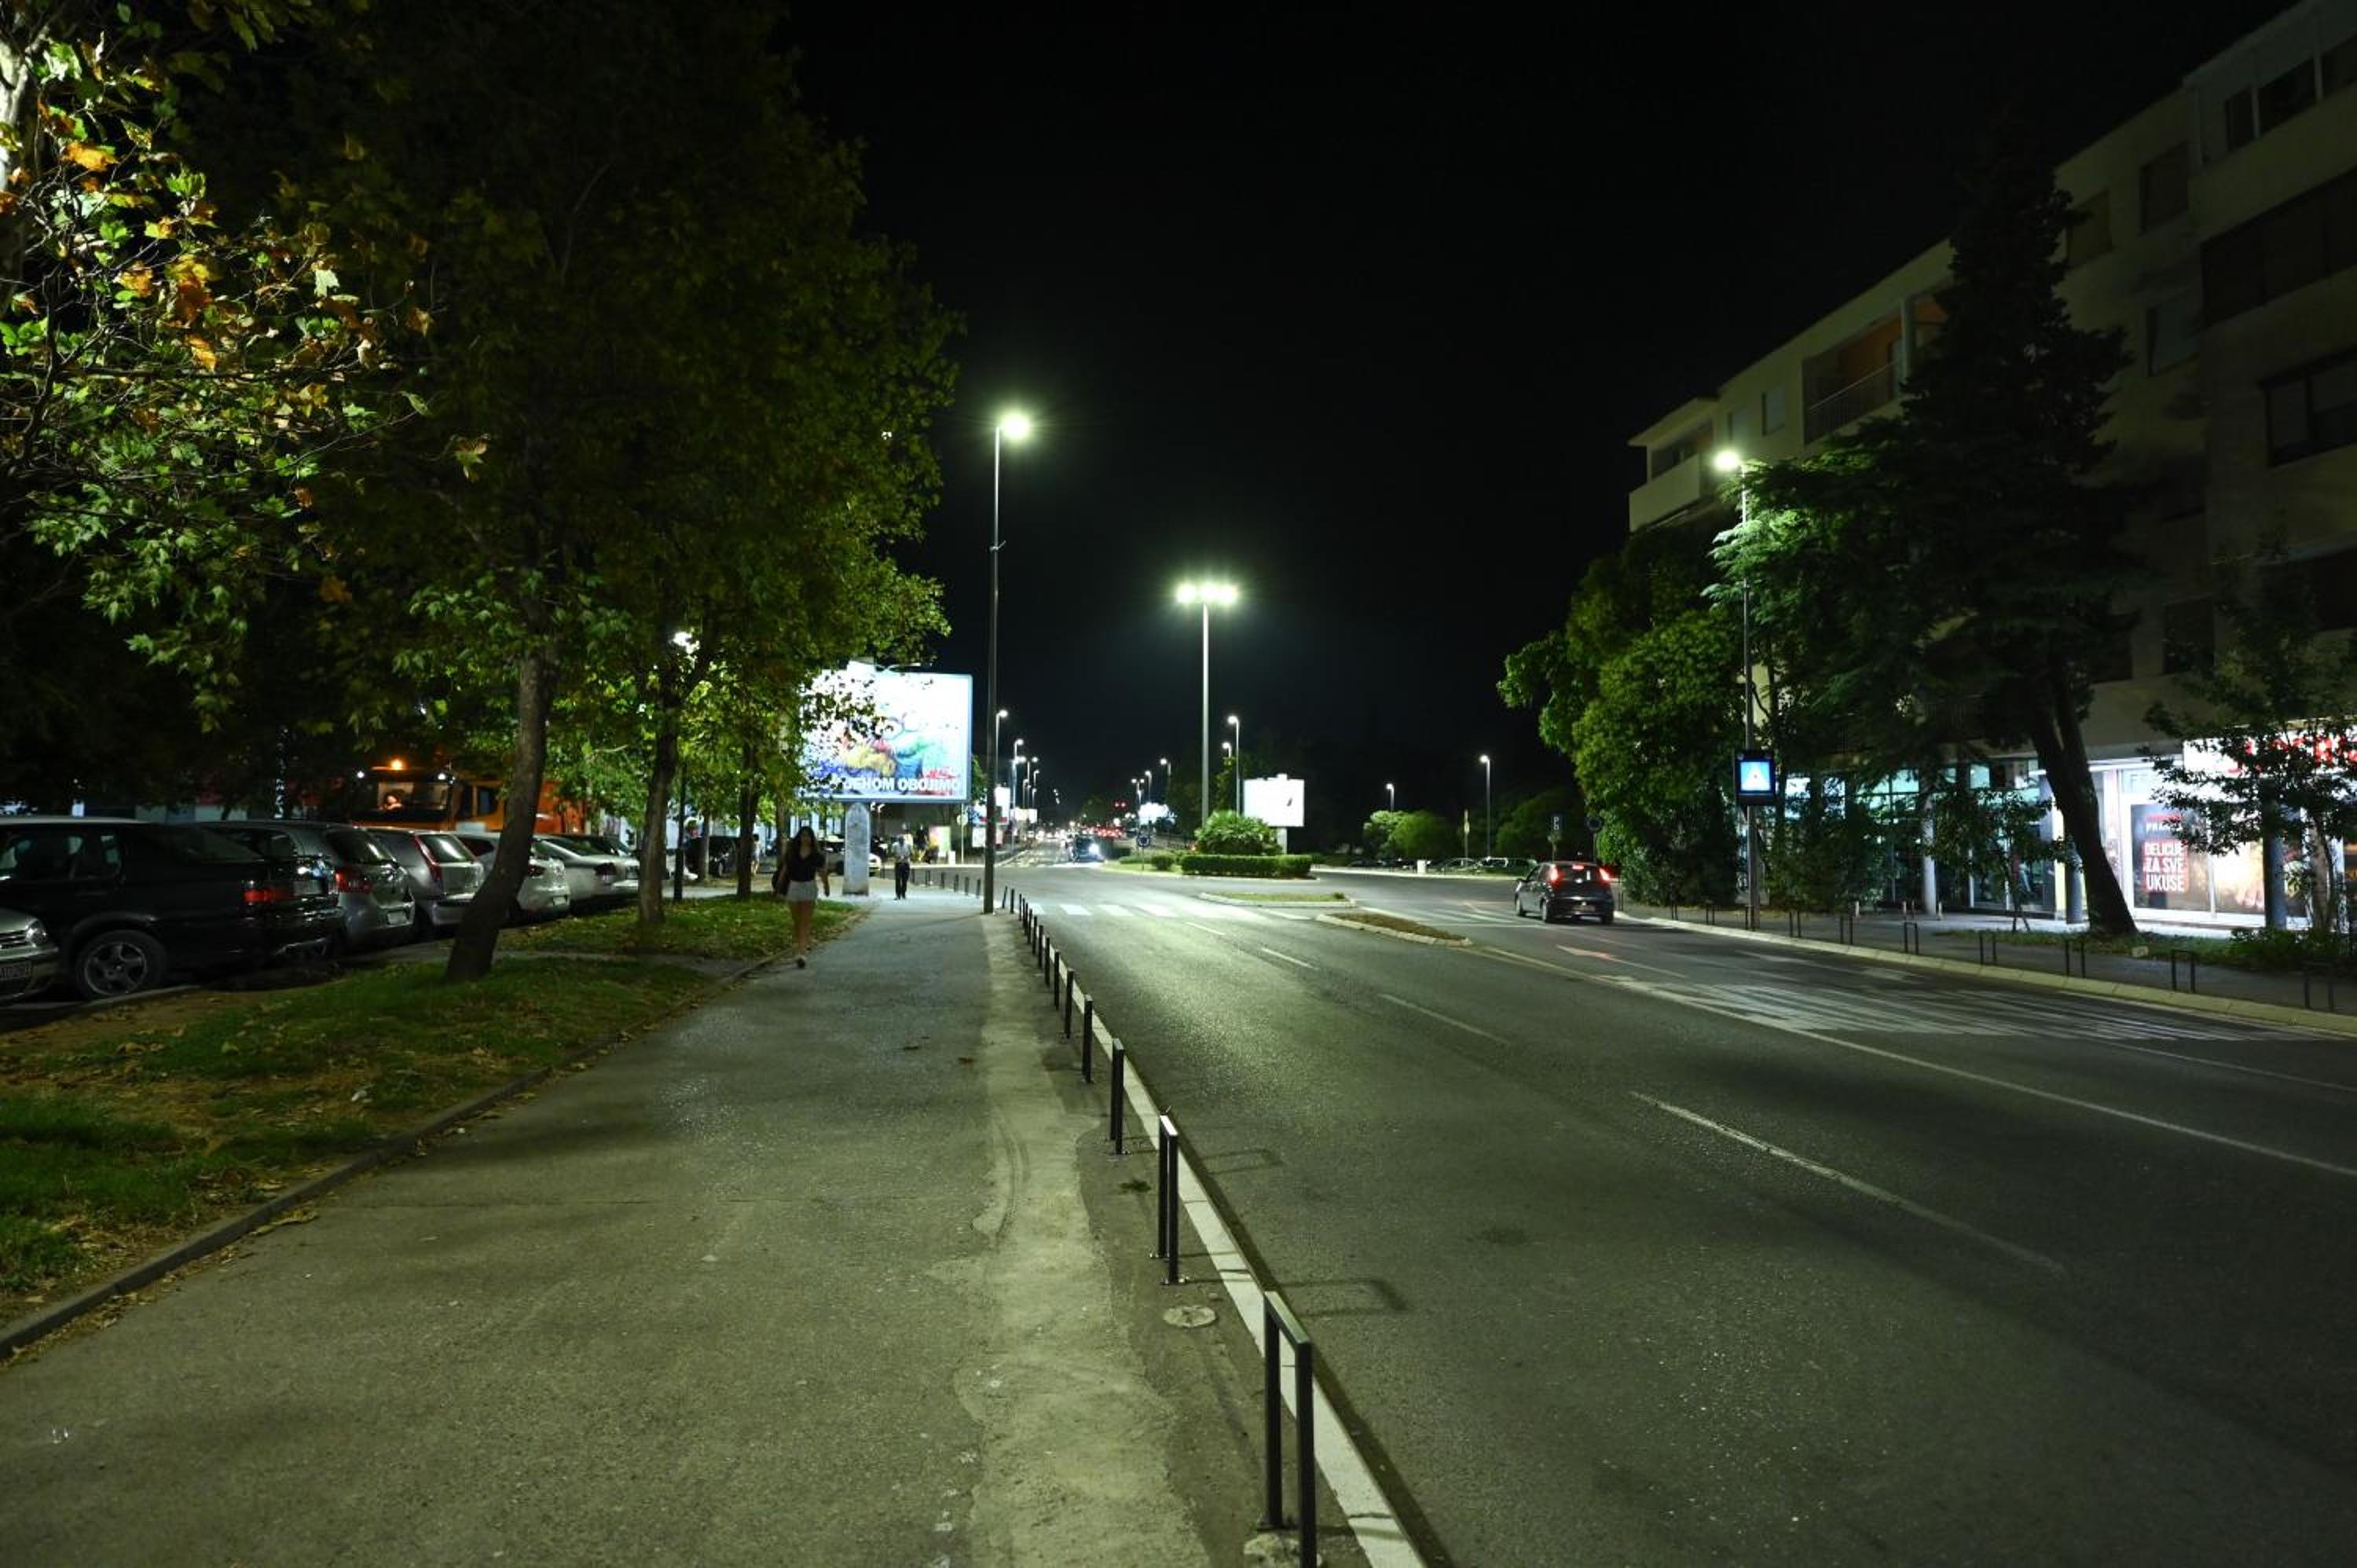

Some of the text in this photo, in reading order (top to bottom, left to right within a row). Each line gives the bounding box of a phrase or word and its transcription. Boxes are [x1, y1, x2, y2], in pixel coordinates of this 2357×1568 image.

[2143, 856, 2184, 873] ZA SVE
[2146, 873, 2185, 892] UKUSE
